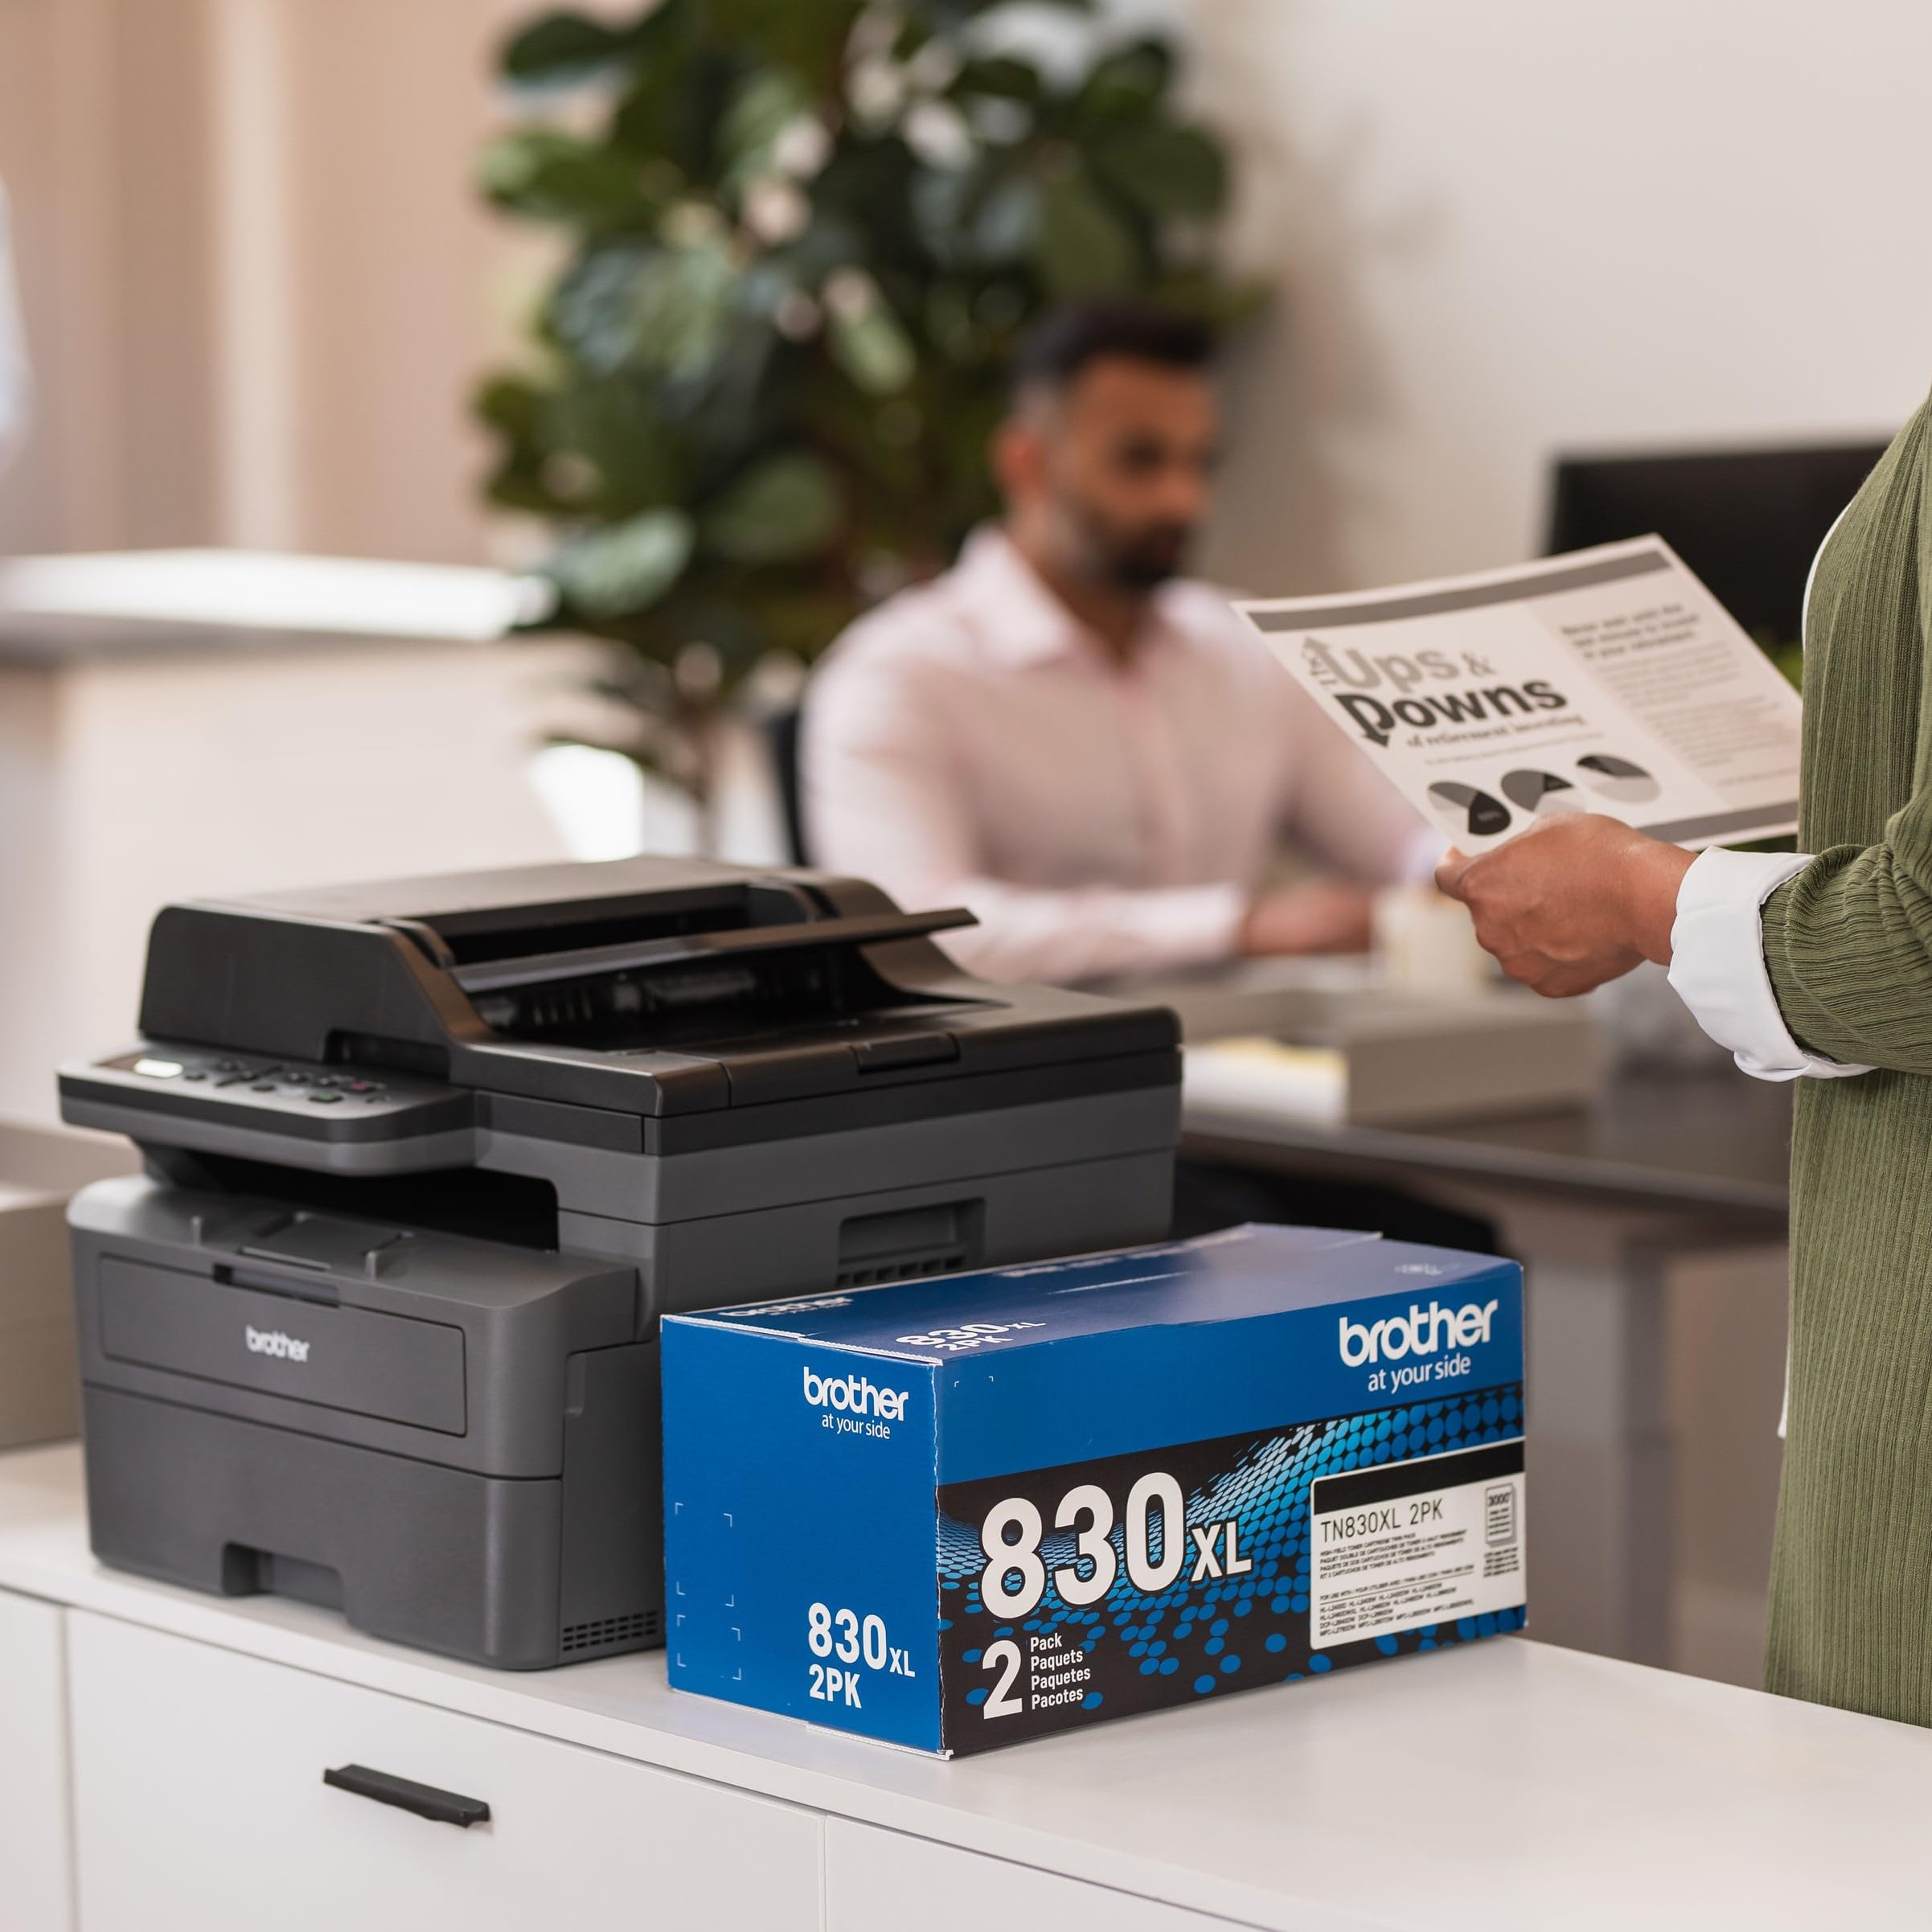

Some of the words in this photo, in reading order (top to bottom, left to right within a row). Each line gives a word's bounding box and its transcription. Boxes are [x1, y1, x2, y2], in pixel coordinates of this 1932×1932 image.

[1306, 635, 1460, 693] Ups
[1461, 651, 1496, 677] &
[1332, 680, 1567, 744] Downs
[245, 1323, 310, 1363] brother
[934, 1335, 1014, 1352] 2PK
[1339, 1298, 1499, 1368] brother
[803, 1366, 909, 1421] brother
[1368, 1368, 1387, 1393] at
[1391, 1360, 1433, 1395] your
[1434, 1352, 1472, 1380] side
[822, 1413, 834, 1429] at
[836, 1417, 864, 1434] your
[865, 1419, 891, 1439] side
[1320, 1507, 1401, 1543] TN830XL
[1409, 1498, 1443, 1525] 2PK
[808, 1602, 916, 1678] 830XL
[1030, 1632, 1062, 1652] Pack
[1031, 1649, 1083, 1672] Paquets
[809, 1663, 862, 1708] 2PK
[982, 1640, 1023, 1719] 2
[1031, 1668, 1091, 1691] Paquetes
[1032, 1688, 1084, 1710] Pacotes
